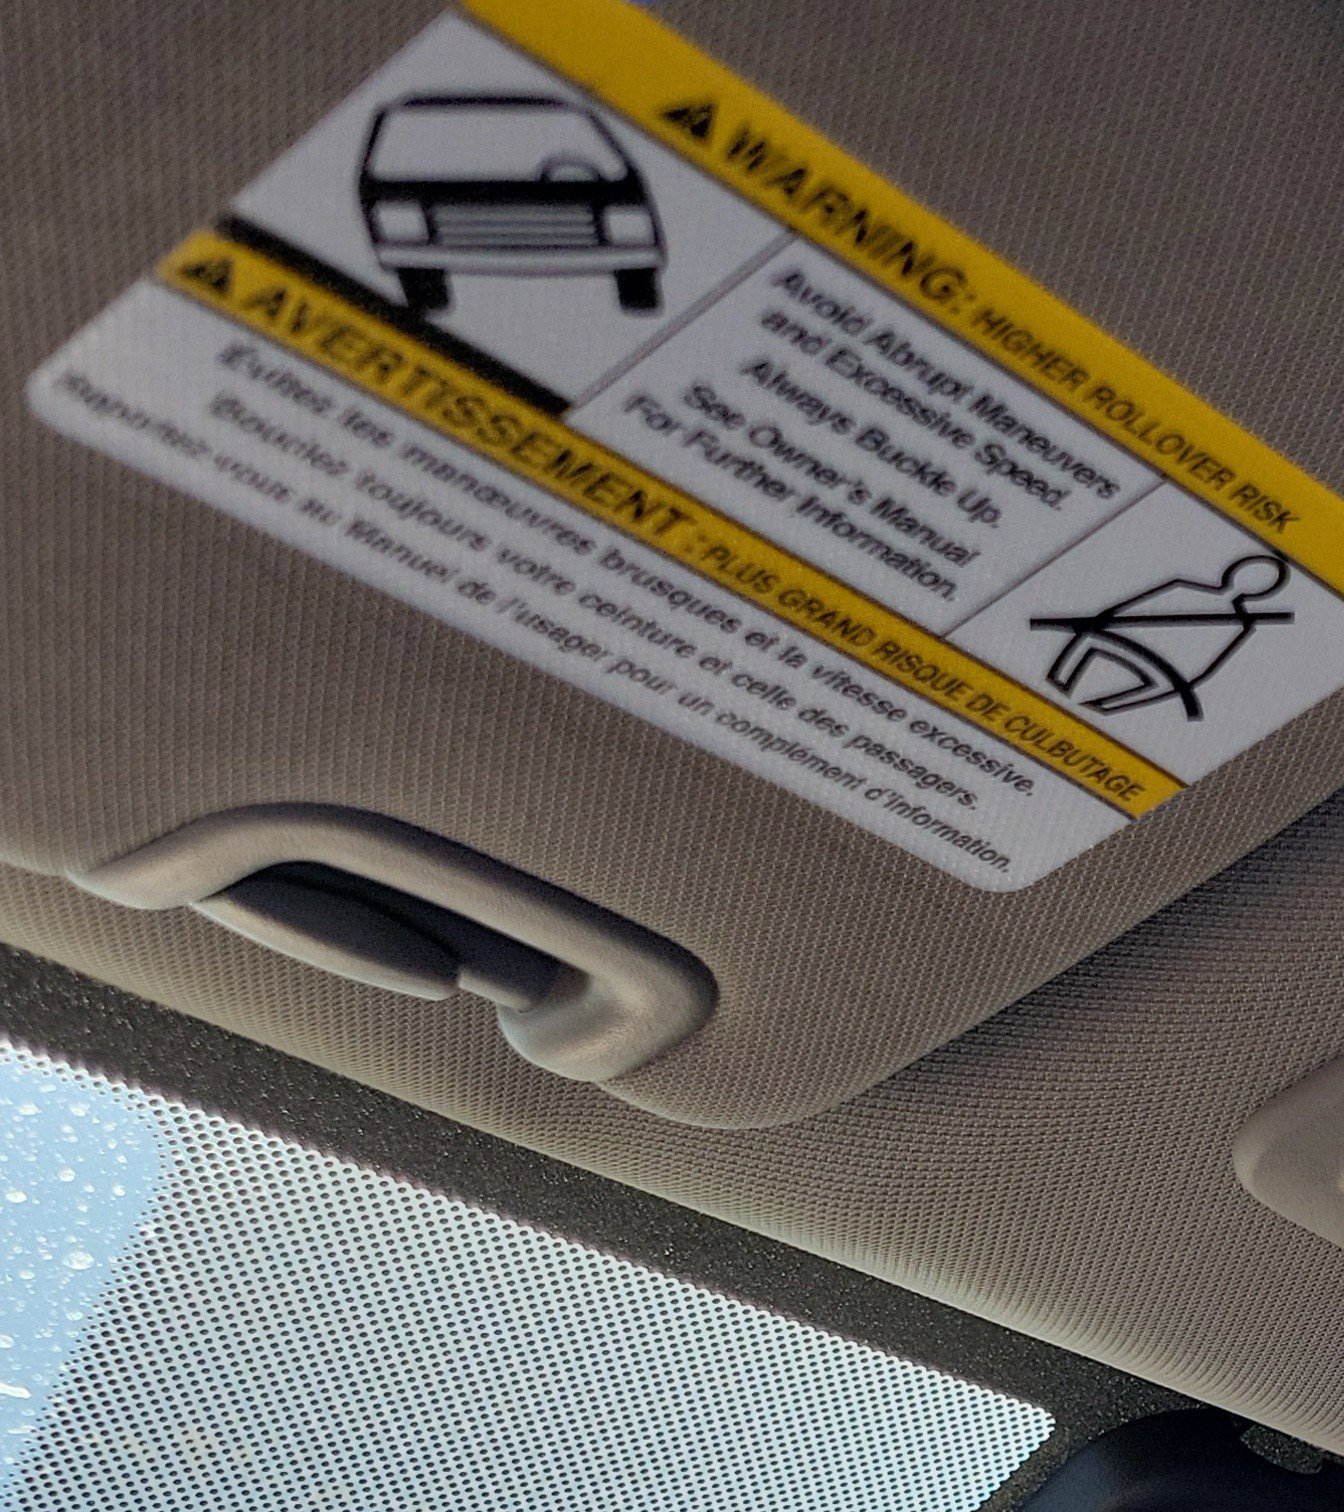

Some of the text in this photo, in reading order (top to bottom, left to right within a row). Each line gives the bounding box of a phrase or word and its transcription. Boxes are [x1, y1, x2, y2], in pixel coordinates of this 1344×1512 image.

[723, 126, 1297, 532] WARNING: HIGHER ROLLOVER RISK
[740, 357, 1011, 531] Always Buckle Up.
[760, 310, 1073, 513] and Excessive Speed.
[772, 269, 1120, 498] Avoid Abrupt Maneuvers
[244, 287, 693, 535] AVERTISSEMENT
[700, 543, 780, 594] PLUS
[777, 588, 875, 646] GRAND
[872, 639, 971, 700] RISQUE
[965, 692, 1009, 721] DE
[1003, 715, 1144, 801] CULBUTAGE
[624, 392, 964, 604] For Further Information.
[683, 384, 980, 566] See Owner's Manual
[355, 471, 492, 552] toujours
[497, 547, 575, 595] votre
[577, 591, 697, 657] ceinture
[698, 654, 733, 676] et
[731, 673, 796, 710] celle
[797, 707, 849, 737] des
[843, 733, 977, 810] passagers.
[456, 579, 495, 604] de
[605, 656, 677, 694] pour
[677, 692, 715, 716] un
[714, 711, 867, 791] complément
[863, 787, 1011, 873] d'information.
[598, 547, 742, 633] brusques
[744, 630, 779, 652] et
[777, 644, 807, 669] la
[811, 664, 907, 721] vitesse
[908, 719, 1034, 792] excessive.
